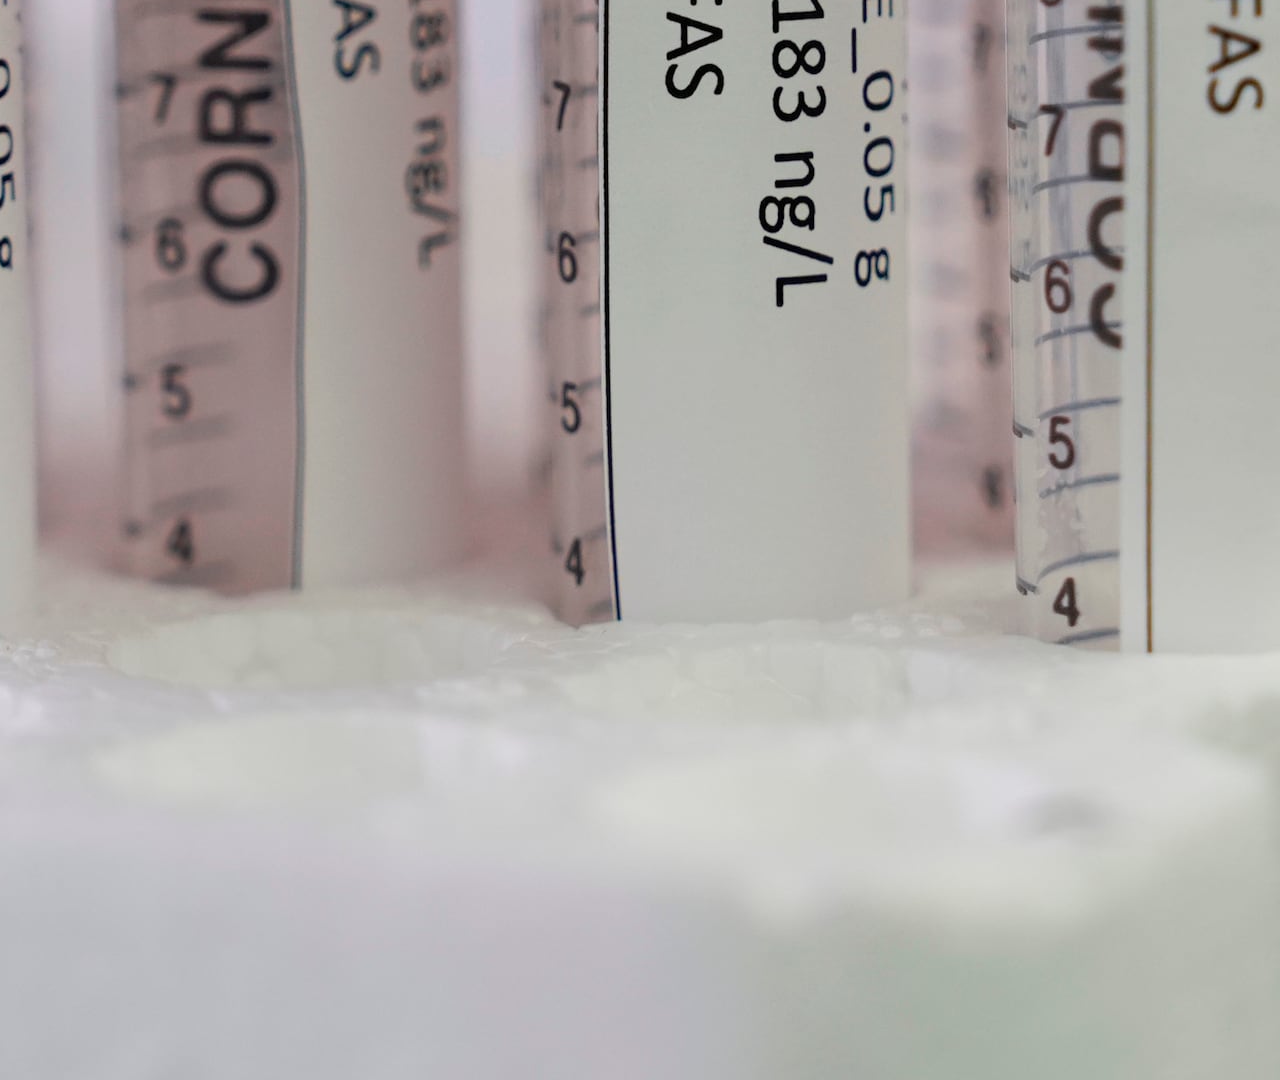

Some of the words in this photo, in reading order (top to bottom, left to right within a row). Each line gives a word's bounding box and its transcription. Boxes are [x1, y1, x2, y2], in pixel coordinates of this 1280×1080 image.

[150, 74, 176, 127] 7
[552, 81, 571, 131] 7
[1039, 104, 1067, 157] 7
[403, 115, 460, 268] ng/L
[154, 218, 186, 273] 6
[759, 151, 834, 308] ng/L
[557, 231, 577, 283] 6
[854, 248, 890, 287] g
[1044, 260, 1072, 314] 6
[161, 364, 191, 418] 5
[561, 382, 581, 433] 5
[1048, 417, 1076, 470] 5
[166, 519, 193, 568] 4
[565, 538, 585, 586] 4
[1053, 577, 1080, 627] 4
